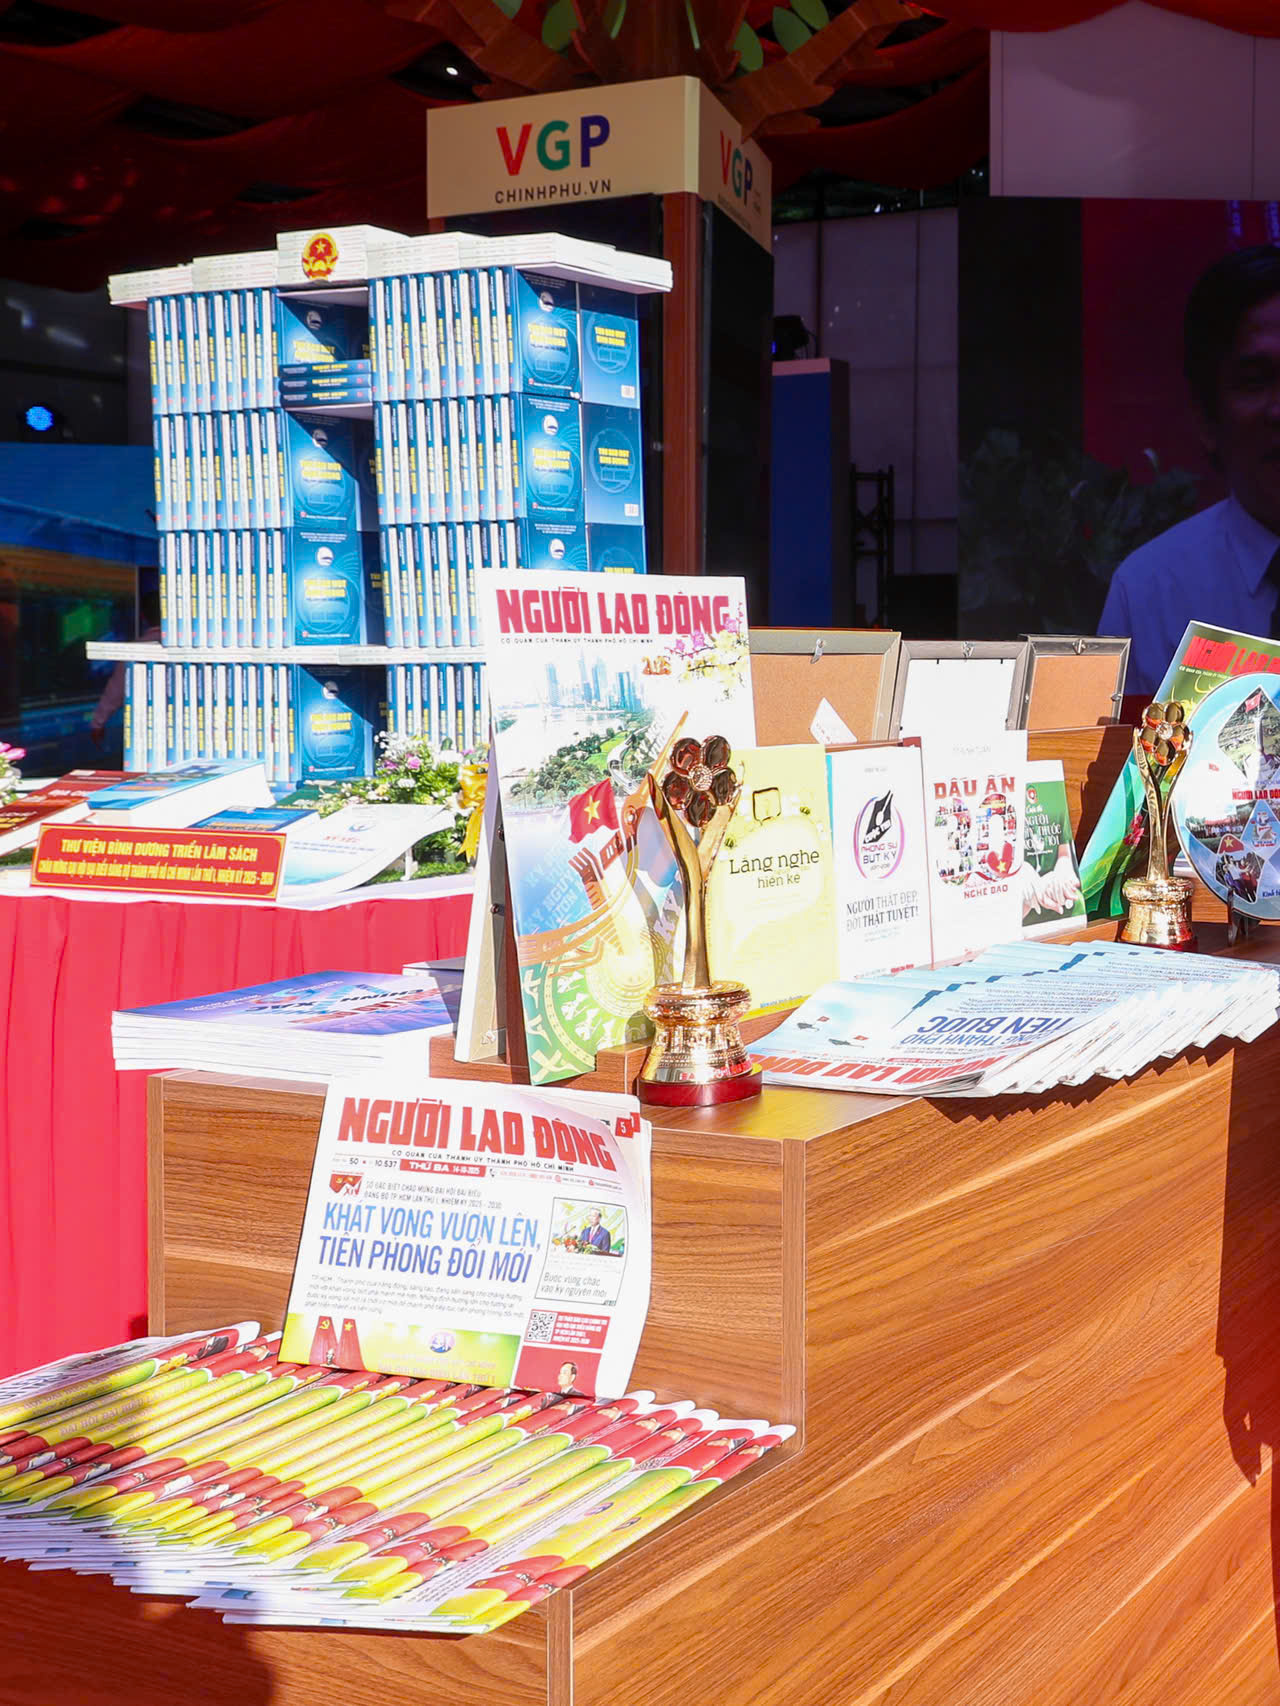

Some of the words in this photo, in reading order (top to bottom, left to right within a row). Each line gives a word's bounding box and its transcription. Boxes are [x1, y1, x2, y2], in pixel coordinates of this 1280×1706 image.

[496, 115, 610, 176] VGP
[720, 129, 753, 207] VGP
[495, 180, 611, 204] CHINHPHU.VN
[496, 586, 592, 634] NGƯỜI
[597, 592, 650, 634] LAO
[655, 591, 730, 637] ĐỘNG
[1230, 648, 1269, 676] LAO
[934, 777, 977, 800] DẤU
[984, 774, 1015, 794] ẤN
[1255, 790, 1268, 800] LAO
[61, 838, 83, 853] THƯ
[83, 838, 107, 857] VIỆN
[107, 838, 133, 856] BÌNH
[134, 841, 170, 858] DƯƠNG
[172, 840, 202, 860] TRIỂN
[203, 843, 227, 861] LÃM
[228, 844, 258, 862] SÁCH
[778, 849, 820, 870] nghe
[822, 1062, 902, 1082] LAO
[337, 1097, 451, 1149] NGƯỜI
[460, 1106, 525, 1155] LAO
[531, 1116, 617, 1172] ĐỘNG
[620, 1121, 627, 1134] 5
[349, 1157, 359, 1165] 50
[409, 1161, 432, 1170] THỨ
[433, 1163, 449, 1172] BA
[323, 1199, 378, 1233] KHÁT
[382, 1207, 433, 1241] VỌNG
[440, 1209, 493, 1244] VƯƠN
[499, 1212, 542, 1249] LÊN,
[318, 1231, 368, 1267] TIÊN
[369, 1240, 440, 1276] PHONG
[446, 1238, 487, 1280] ĐỔI
[489, 1246, 533, 1284] MỚI
